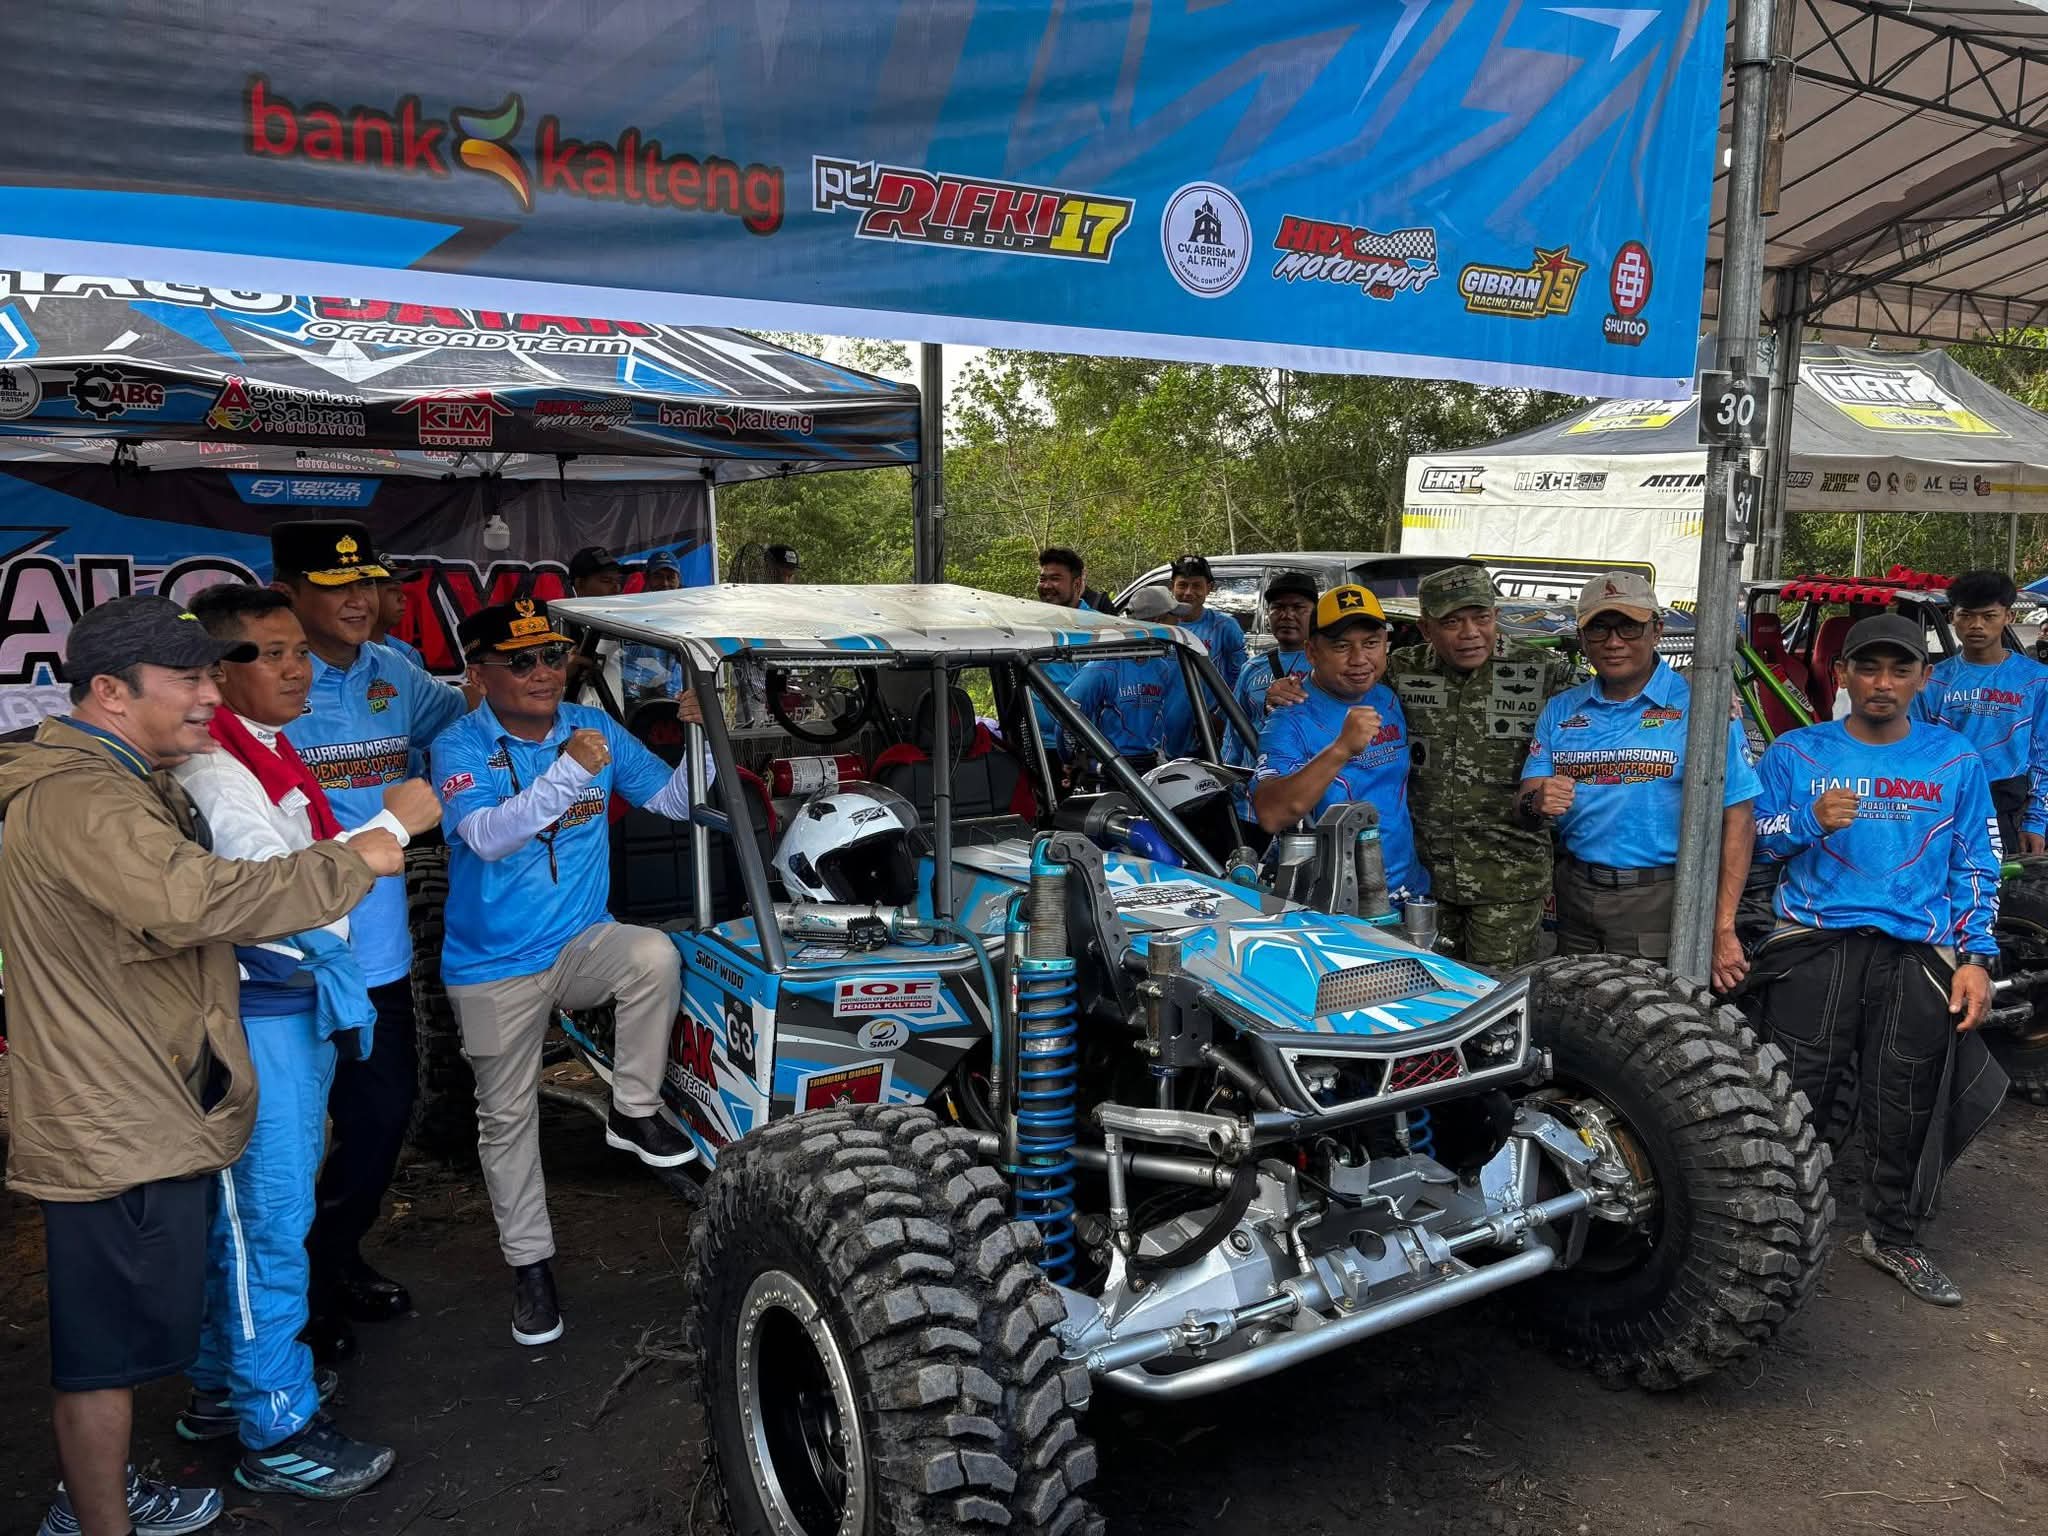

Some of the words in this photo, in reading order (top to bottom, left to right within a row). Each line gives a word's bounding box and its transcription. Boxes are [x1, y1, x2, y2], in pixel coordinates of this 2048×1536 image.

[248, 78, 450, 177] bank
[538, 117, 784, 233] kalteng
[864, 172, 1060, 238] RIFKI
[1050, 200, 1127, 254] 17
[943, 229, 1034, 248] GROUP
[1187, 255, 1199, 266] AL
[1201, 256, 1227, 268] FATIH
[1193, 246, 1236, 259] ABRISAM
[1464, 271, 1541, 299] GIBRAN
[1474, 296, 1507, 309] RACING
[1509, 299, 1534, 311] TEAM
[1604, 318, 1647, 336] SHUTOO
[308, 322, 509, 350] OFFROAD
[515, 335, 631, 354] TEAM
[109, 383, 164, 405] ABG
[269, 401, 365, 425] Sabran
[1716, 393, 1756, 426] 30
[264, 420, 366, 437] FOUNDATION
[658, 403, 714, 427] bank
[737, 405, 814, 436] kalteng
[420, 436, 493, 446] PROPERTY
[1735, 491, 1753, 524] 31
[1495, 701, 1516, 712] TNI
[1518, 702, 1537, 713] AD
[1552, 749, 1616, 764] KEJUARAAN
[1617, 748, 1679, 764] NASIONAL
[1616, 761, 1673, 777] OFFROAD
[1875, 777, 1943, 803] DAYAK
[695, 950, 719, 970] SIGIT
[720, 966, 744, 990] WIDO
[841, 982, 934, 997] IOF
[841, 1002, 883, 1011] PENGDA
[869, 1040, 899, 1049] SMN
[681, 1070, 711, 1107] TEAM
